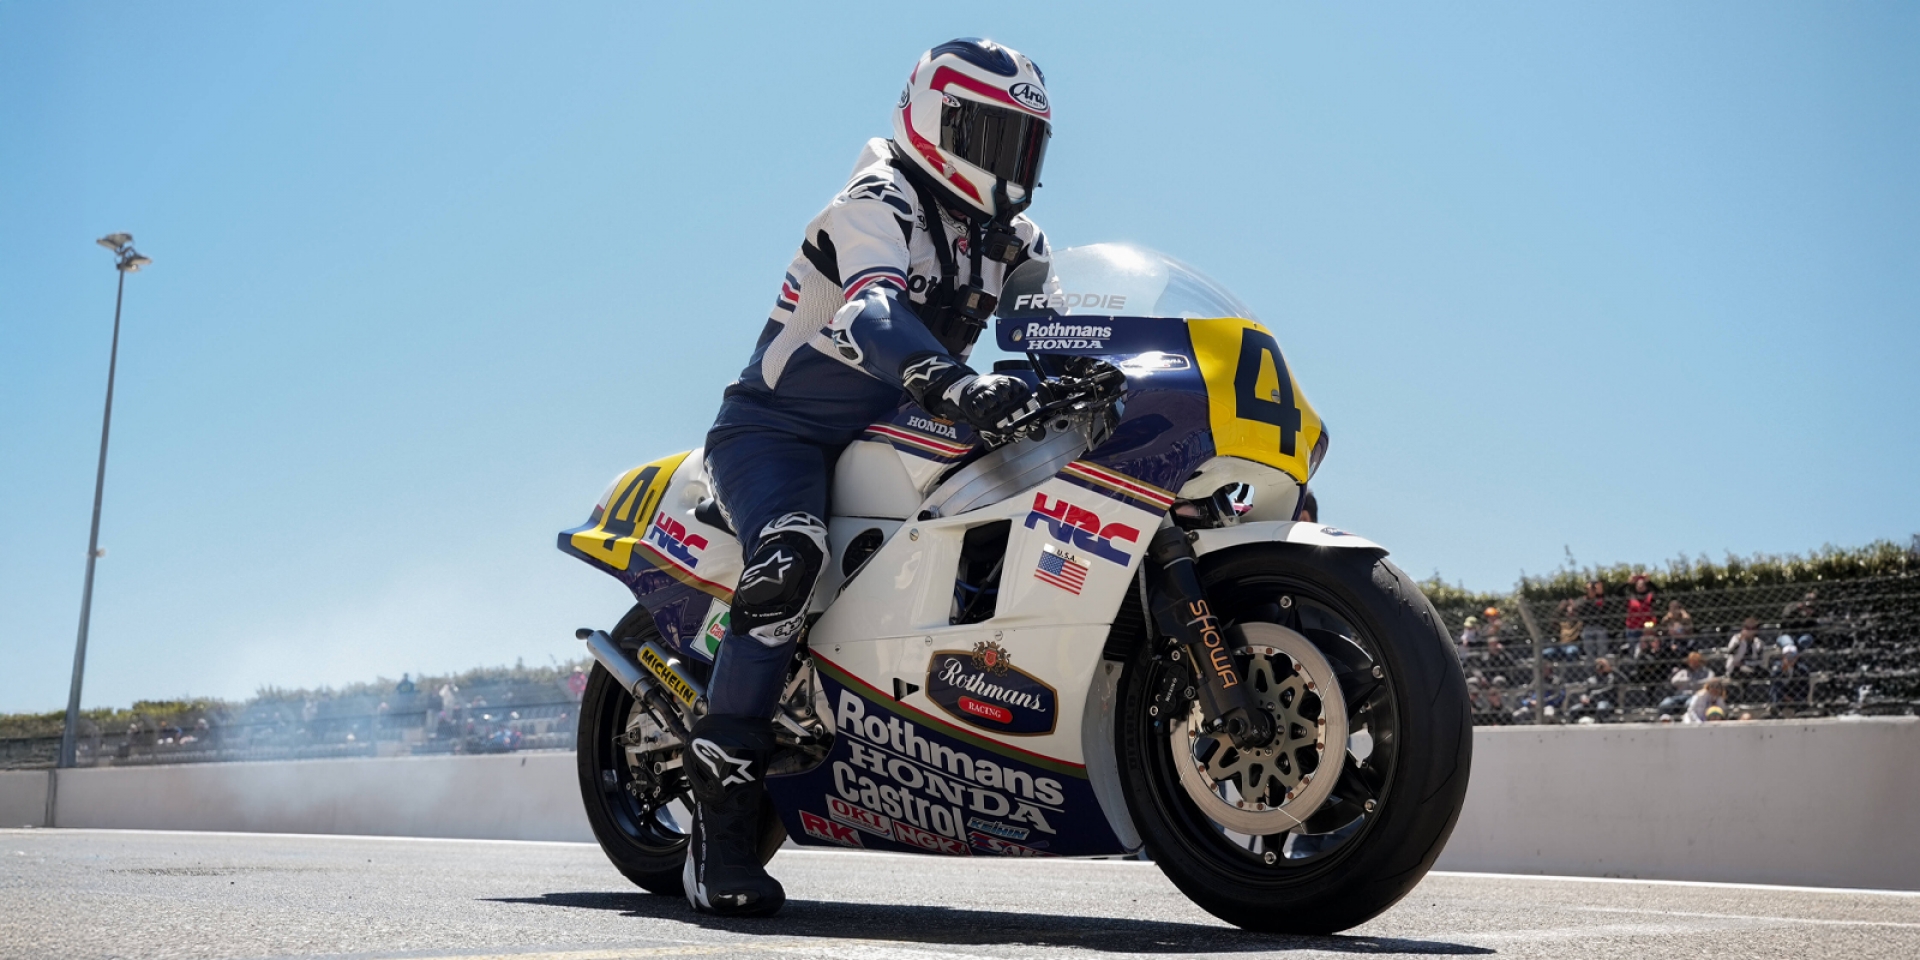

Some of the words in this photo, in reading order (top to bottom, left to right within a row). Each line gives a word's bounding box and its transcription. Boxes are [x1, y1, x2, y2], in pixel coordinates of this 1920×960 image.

[1014, 293, 1127, 310] FREDDIE
[1025, 322, 1112, 338] Rothmans
[1027, 340, 1103, 350] HONDA
[1234, 327, 1301, 457] 4
[906, 415, 957, 439] HONDA
[600, 466, 661, 552] 4
[1024, 491, 1140, 567] HRC
[649, 511, 709, 569] HRC
[1056, 549, 1078, 563] U.S.A.
[1189, 599, 1238, 689] SHOWA
[641, 649, 694, 703] MICHELIN
[938, 657, 1046, 713] Rothmans
[968, 701, 1002, 719] RACING
[837, 688, 1065, 805] Rothmans
[832, 798, 885, 830] OKI
[833, 761, 967, 842] Castrol
[847, 740, 1056, 834] HONDA
[801, 811, 860, 847] RK
[897, 824, 958, 856] NGK
